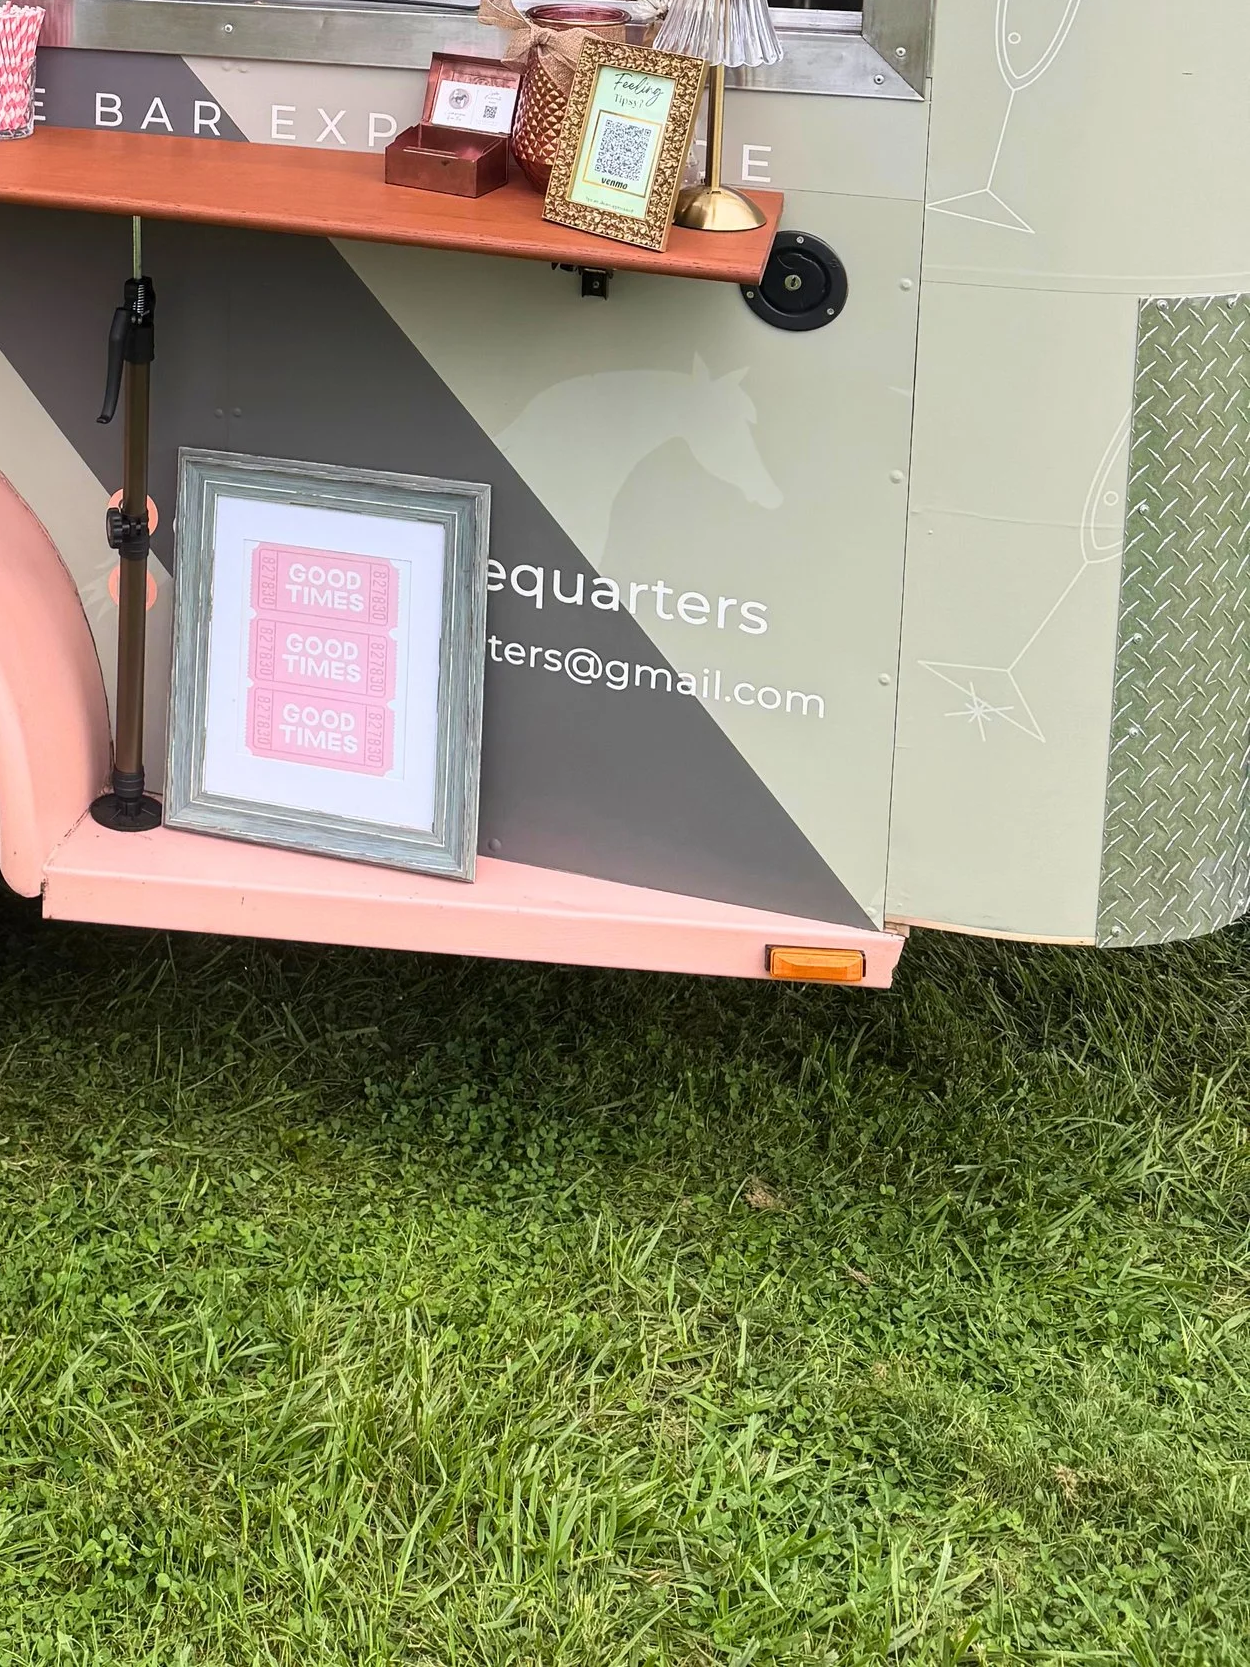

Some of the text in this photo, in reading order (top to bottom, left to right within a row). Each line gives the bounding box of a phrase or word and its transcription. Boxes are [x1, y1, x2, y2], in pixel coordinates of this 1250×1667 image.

[614, 72, 664, 107] Feeling
[614, 93, 644, 109] Tipsy?
[95, 91, 223, 137] BAR
[601, 177, 628, 190] venmo
[260, 555, 276, 608] 827830
[288, 563, 362, 591] GOOD
[285, 583, 365, 613] TIMES
[371, 568, 388, 622] 827830
[257, 625, 273, 677] 827830
[285, 632, 359, 661] GOOD
[282, 653, 362, 683] TIMES
[369, 641, 386, 694] 827830
[254, 694, 271, 746] 827830
[282, 702, 356, 732] GOOD
[279, 723, 359, 755] TIMES
[366, 711, 383, 763] 827830
